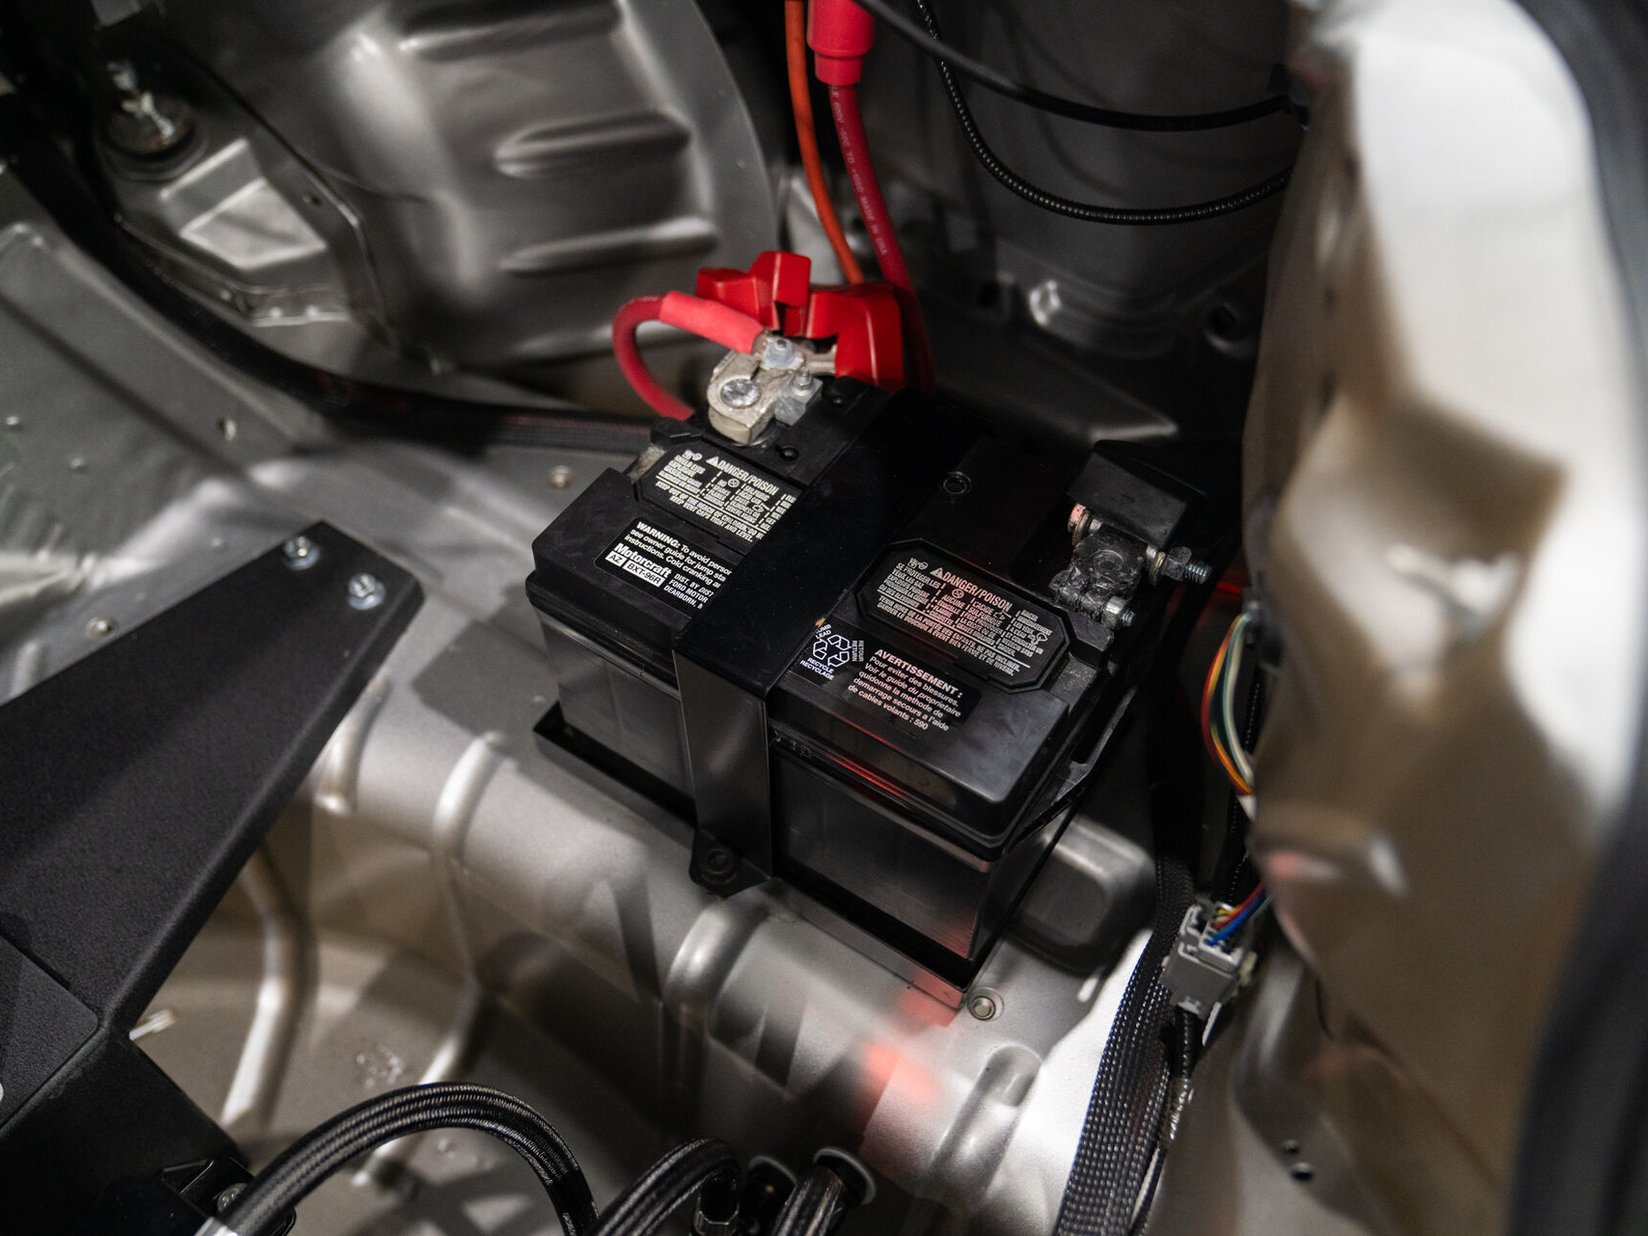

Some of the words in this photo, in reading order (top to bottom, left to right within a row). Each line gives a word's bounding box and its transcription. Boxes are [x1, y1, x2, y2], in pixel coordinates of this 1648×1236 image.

[860, 196, 873, 220] MADE
[871, 224, 879, 233] IN
[875, 237, 887, 255] USA
[716, 460, 778, 495] DANGER/POISON
[655, 481, 670, 490] KEEP
[687, 497, 698, 505] THE
[696, 502, 714, 513] REACH
[670, 495, 684, 504] KEEP
[683, 502, 697, 511] VENT
[696, 509, 710, 518] CAPS
[724, 524, 737, 532] AND
[609, 554, 622, 562] AZ
[614, 542, 672, 577] Motorcraft
[624, 534, 666, 559] instructions.
[665, 556, 683, 567] Cold
[681, 565, 713, 584] cranking
[630, 529, 643, 537] see
[643, 536, 665, 549] owner
[663, 546, 685, 560] guide
[684, 557, 696, 565] for
[694, 562, 714, 575] jump
[636, 521, 681, 548] WARNING:
[689, 550, 709, 563] avoid
[627, 563, 661, 583] BXT-96R
[669, 579, 686, 590] FORD
[685, 588, 708, 602] MOTOR
[674, 573, 691, 584] DIST.
[895, 562, 904, 570] SE
[928, 579, 941, 588] LES
[663, 585, 698, 606] DEARBORN,
[941, 594, 965, 608] AUCUNE
[942, 572, 1013, 611] DANGER/POISON
[972, 601, 994, 614] L'ACIDE
[968, 607, 1001, 626] SULFURIQUE
[816, 630, 832, 640] LEAD
[800, 660, 834, 681] RECYCLAGE
[807, 657, 834, 673] RECYCLE
[869, 656, 887, 668] Pour
[887, 665, 908, 678] eviter
[908, 676, 923, 686] des
[922, 684, 960, 706] blessures.
[875, 648, 958, 694] AVERTISSEMENT
[848, 684, 858, 692] de
[858, 689, 882, 704] cables
[882, 702, 909, 719] volants
[913, 719, 928, 729] 590
[852, 677, 892, 701] demarrage
[892, 698, 921, 716] secours
[928, 716, 949, 730] l'aide
[857, 670, 892, 691] quidonne
[900, 692, 933, 711] methode
[932, 709, 944, 717] de
[864, 663, 879, 673] Voir
[886, 675, 908, 689] guide
[907, 686, 918, 694] du
[917, 692, 961, 717] proprietaire
